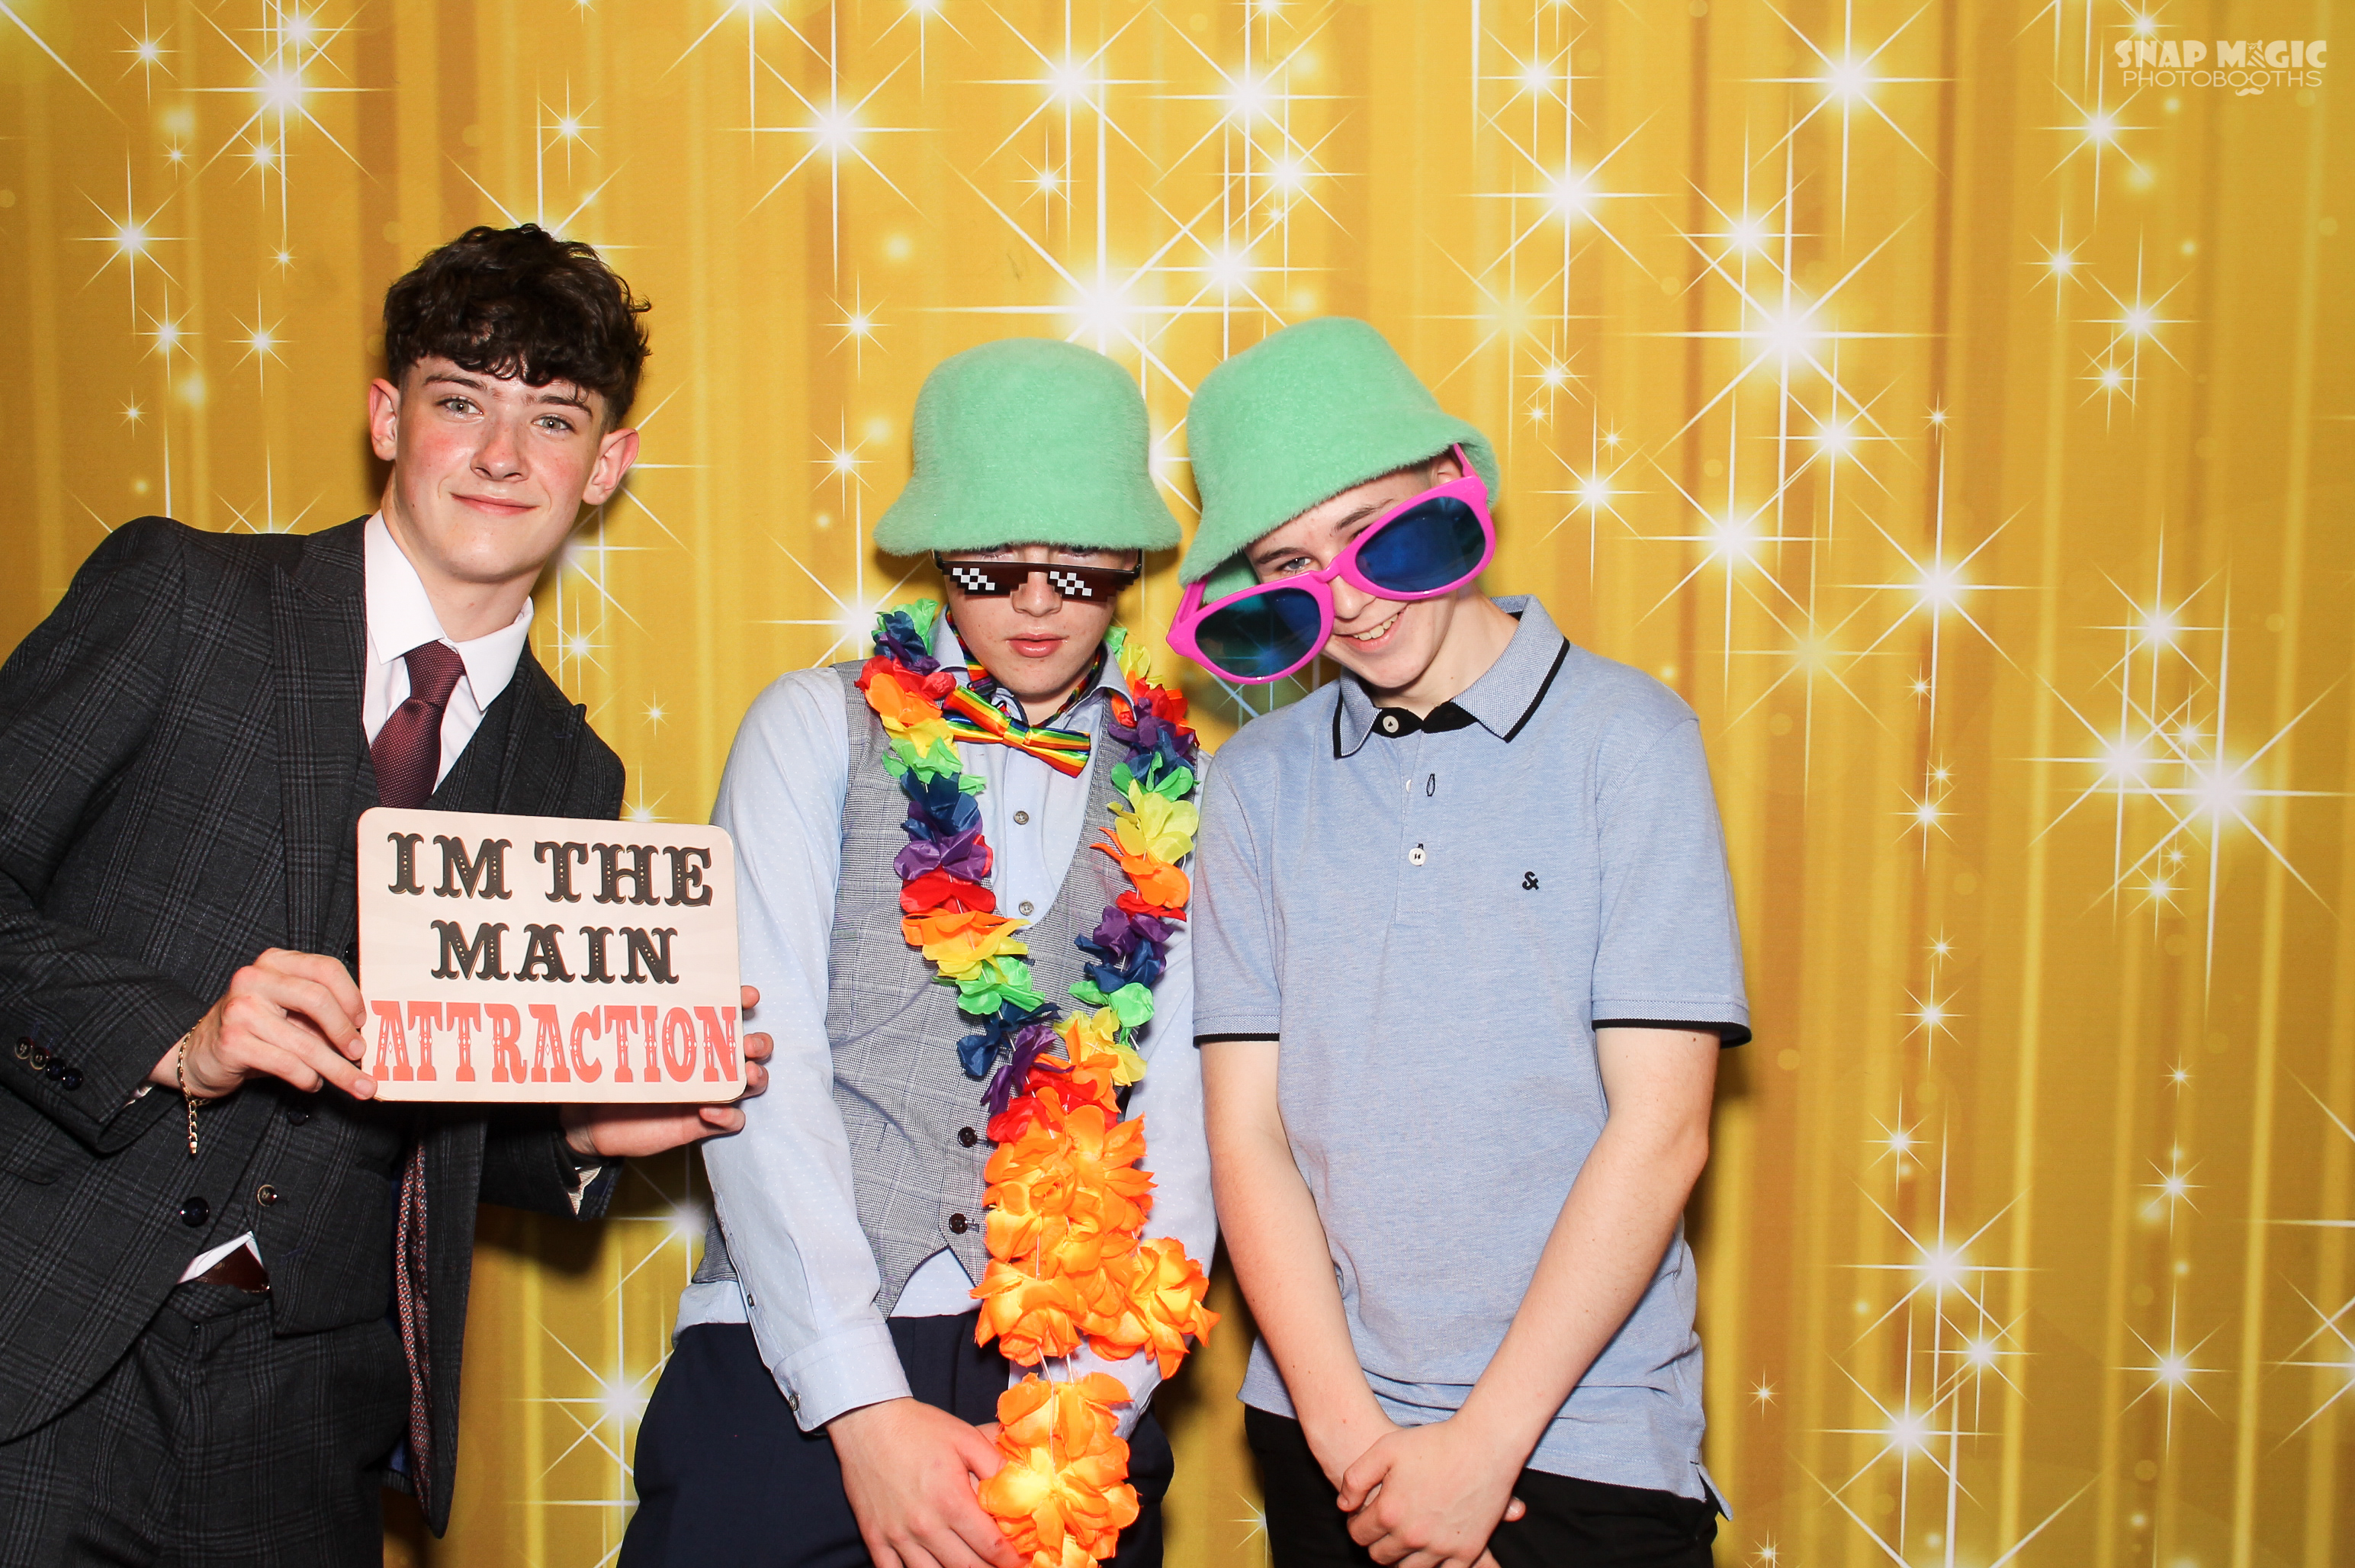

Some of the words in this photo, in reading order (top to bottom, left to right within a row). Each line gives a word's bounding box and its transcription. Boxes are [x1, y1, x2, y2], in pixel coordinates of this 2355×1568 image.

[387, 831, 512, 901] IM
[534, 840, 713, 907] THE
[1521, 871, 1539, 891] &
[430, 920, 680, 985] MAIN
[371, 1000, 738, 1084] ATTRACTION
